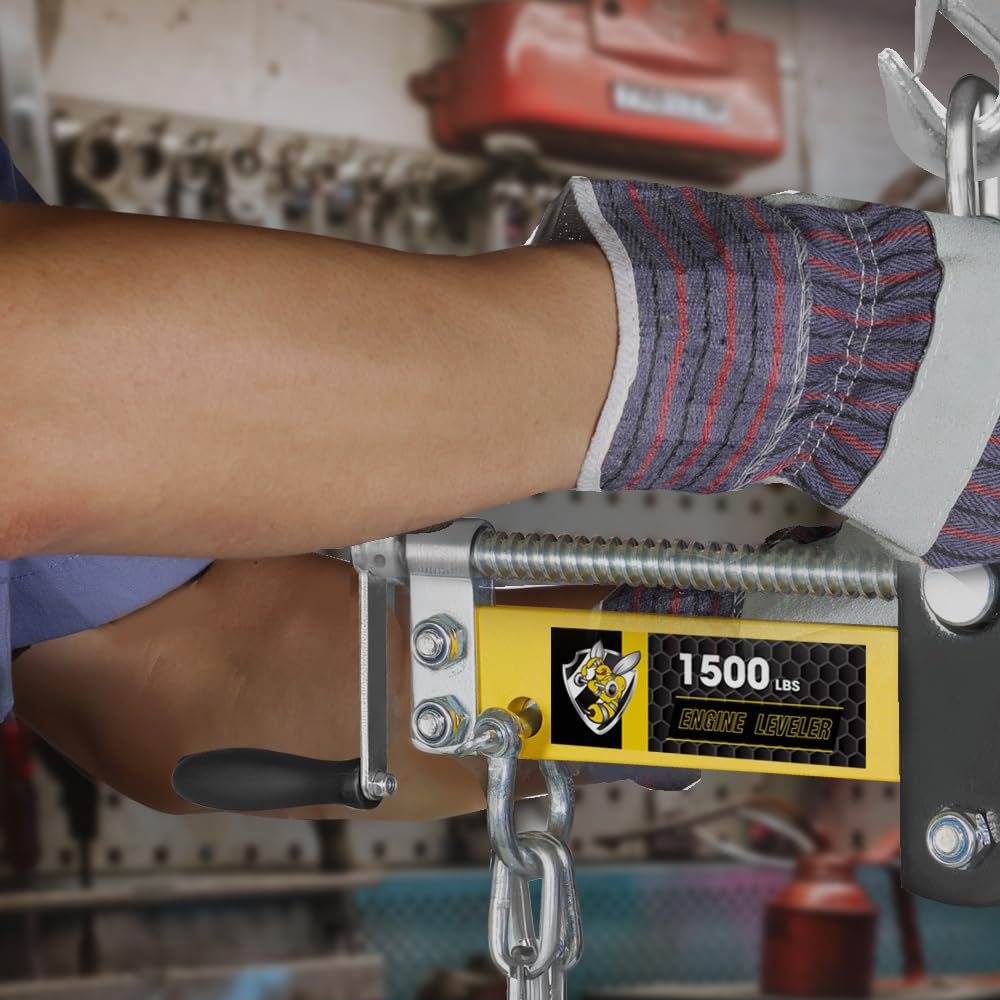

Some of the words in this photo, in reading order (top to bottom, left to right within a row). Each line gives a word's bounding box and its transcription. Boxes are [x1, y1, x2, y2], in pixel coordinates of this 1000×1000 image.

[679, 652, 770, 691] 1500
[775, 679, 801, 692] LBS
[678, 707, 747, 734] ENGINE
[754, 713, 833, 740] LEVELER
